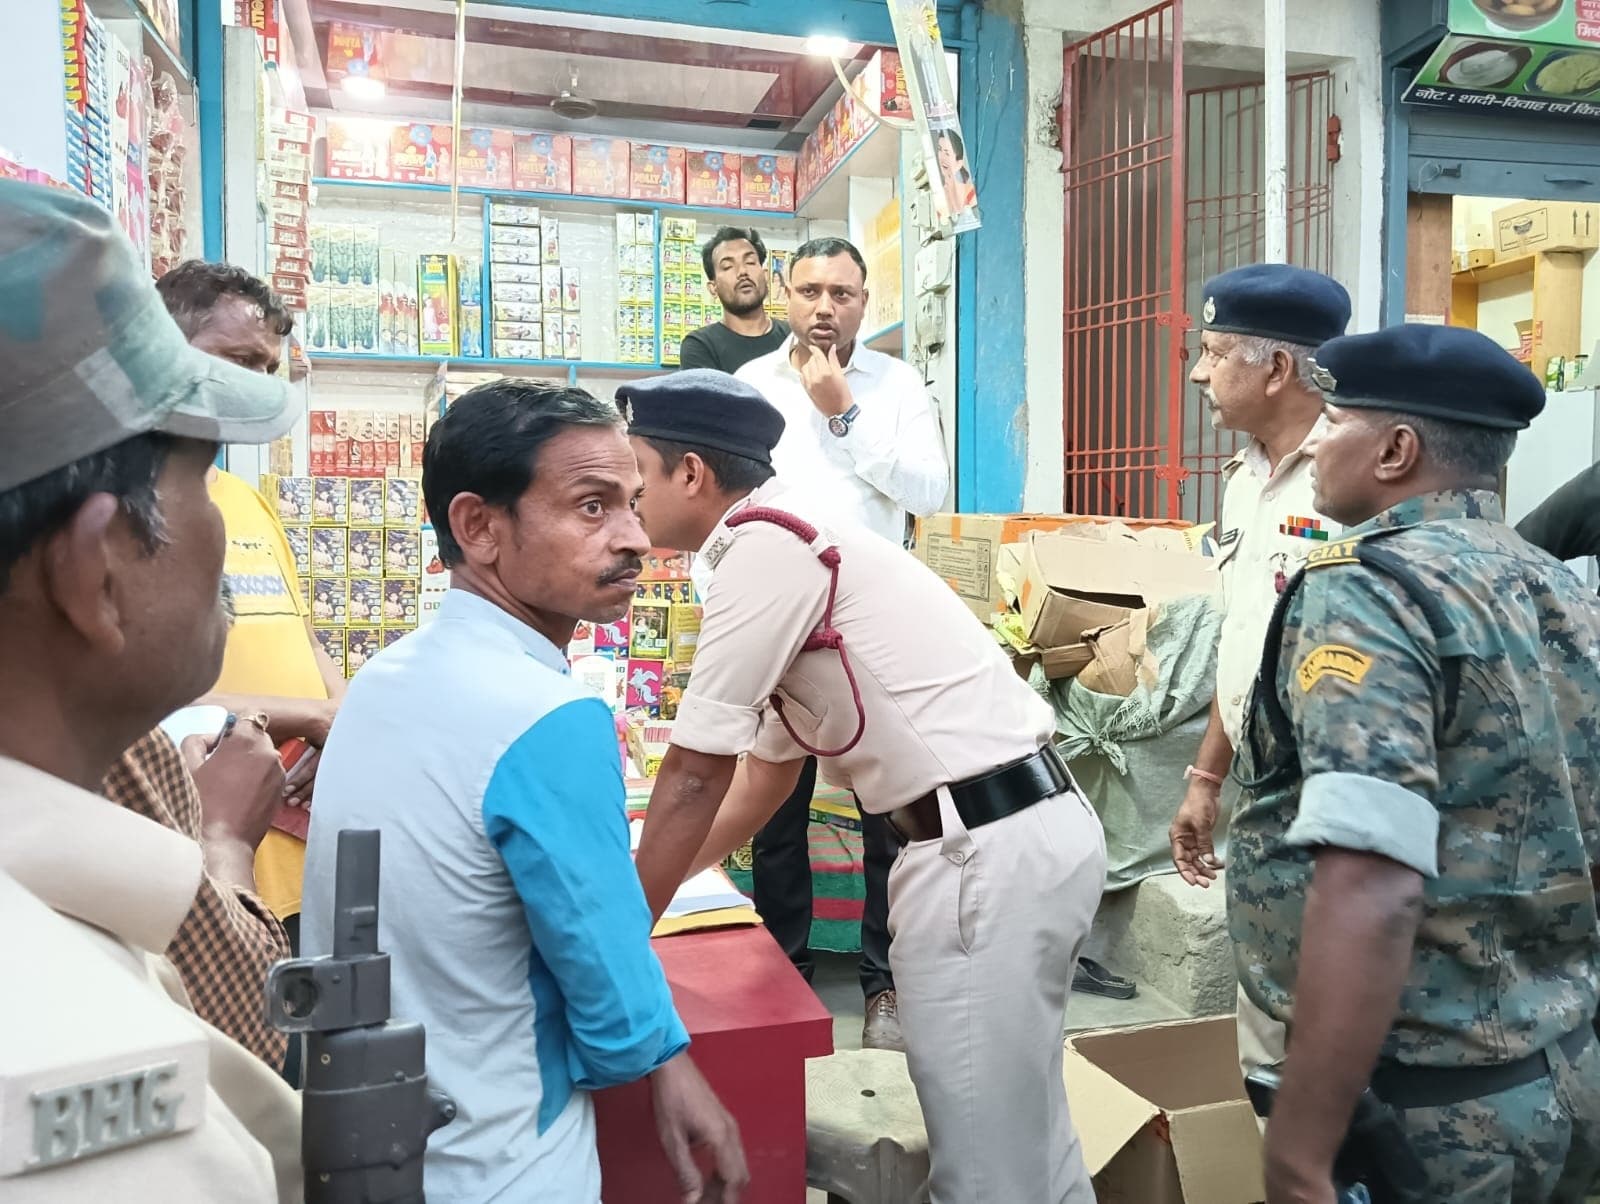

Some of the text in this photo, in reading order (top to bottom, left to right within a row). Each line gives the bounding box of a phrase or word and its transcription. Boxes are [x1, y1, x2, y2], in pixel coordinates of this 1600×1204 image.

[251, 0, 265, 30] OLLY
[1415, 88, 1447, 100] नोट
[1548, 101, 1577, 113] एवं
[1308, 542, 1357, 562] CIAT
[27, 1060, 184, 1166] BHG
